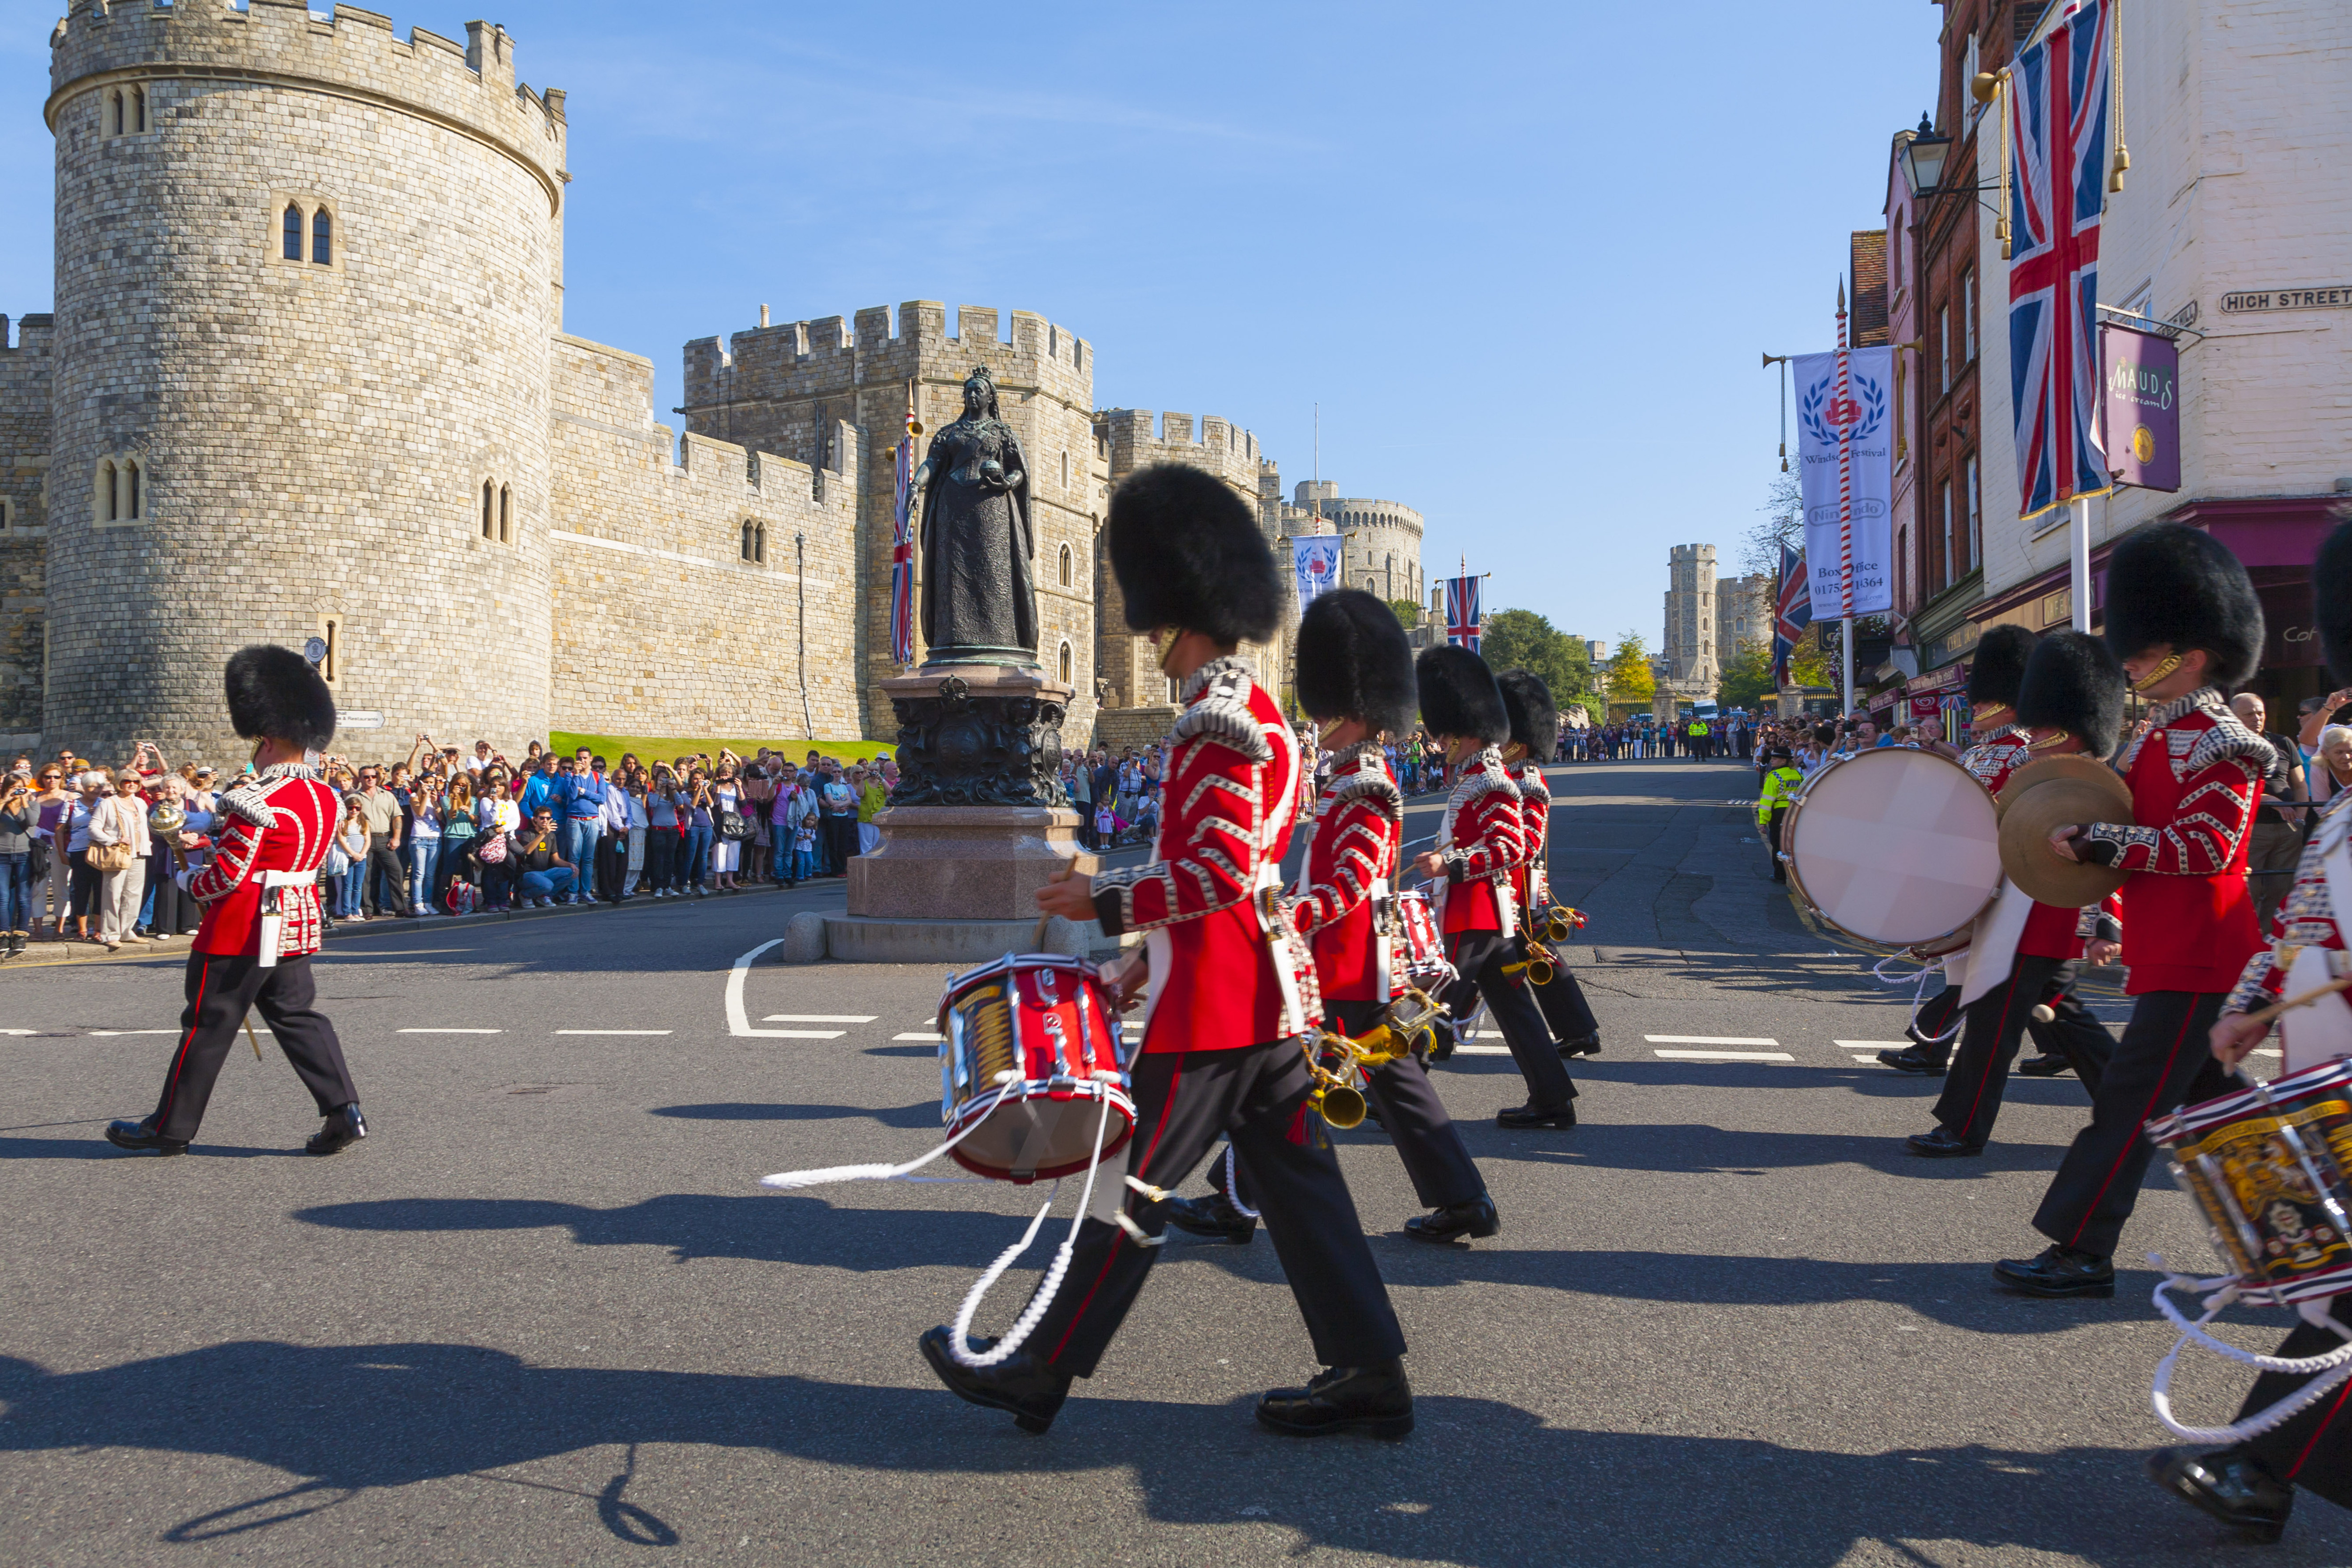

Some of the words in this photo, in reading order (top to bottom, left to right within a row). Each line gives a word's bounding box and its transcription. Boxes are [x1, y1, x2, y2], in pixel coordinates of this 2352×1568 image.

[2227, 294, 2269, 310] HIGH
[2279, 289, 2352, 306] STREET
[2108, 364, 2172, 410] MAUDS
[2115, 390, 2126, 400] ice
[2130, 396, 2160, 408] cream
[1851, 447, 1886, 459] Festival
[1818, 567, 1842, 578] Box
